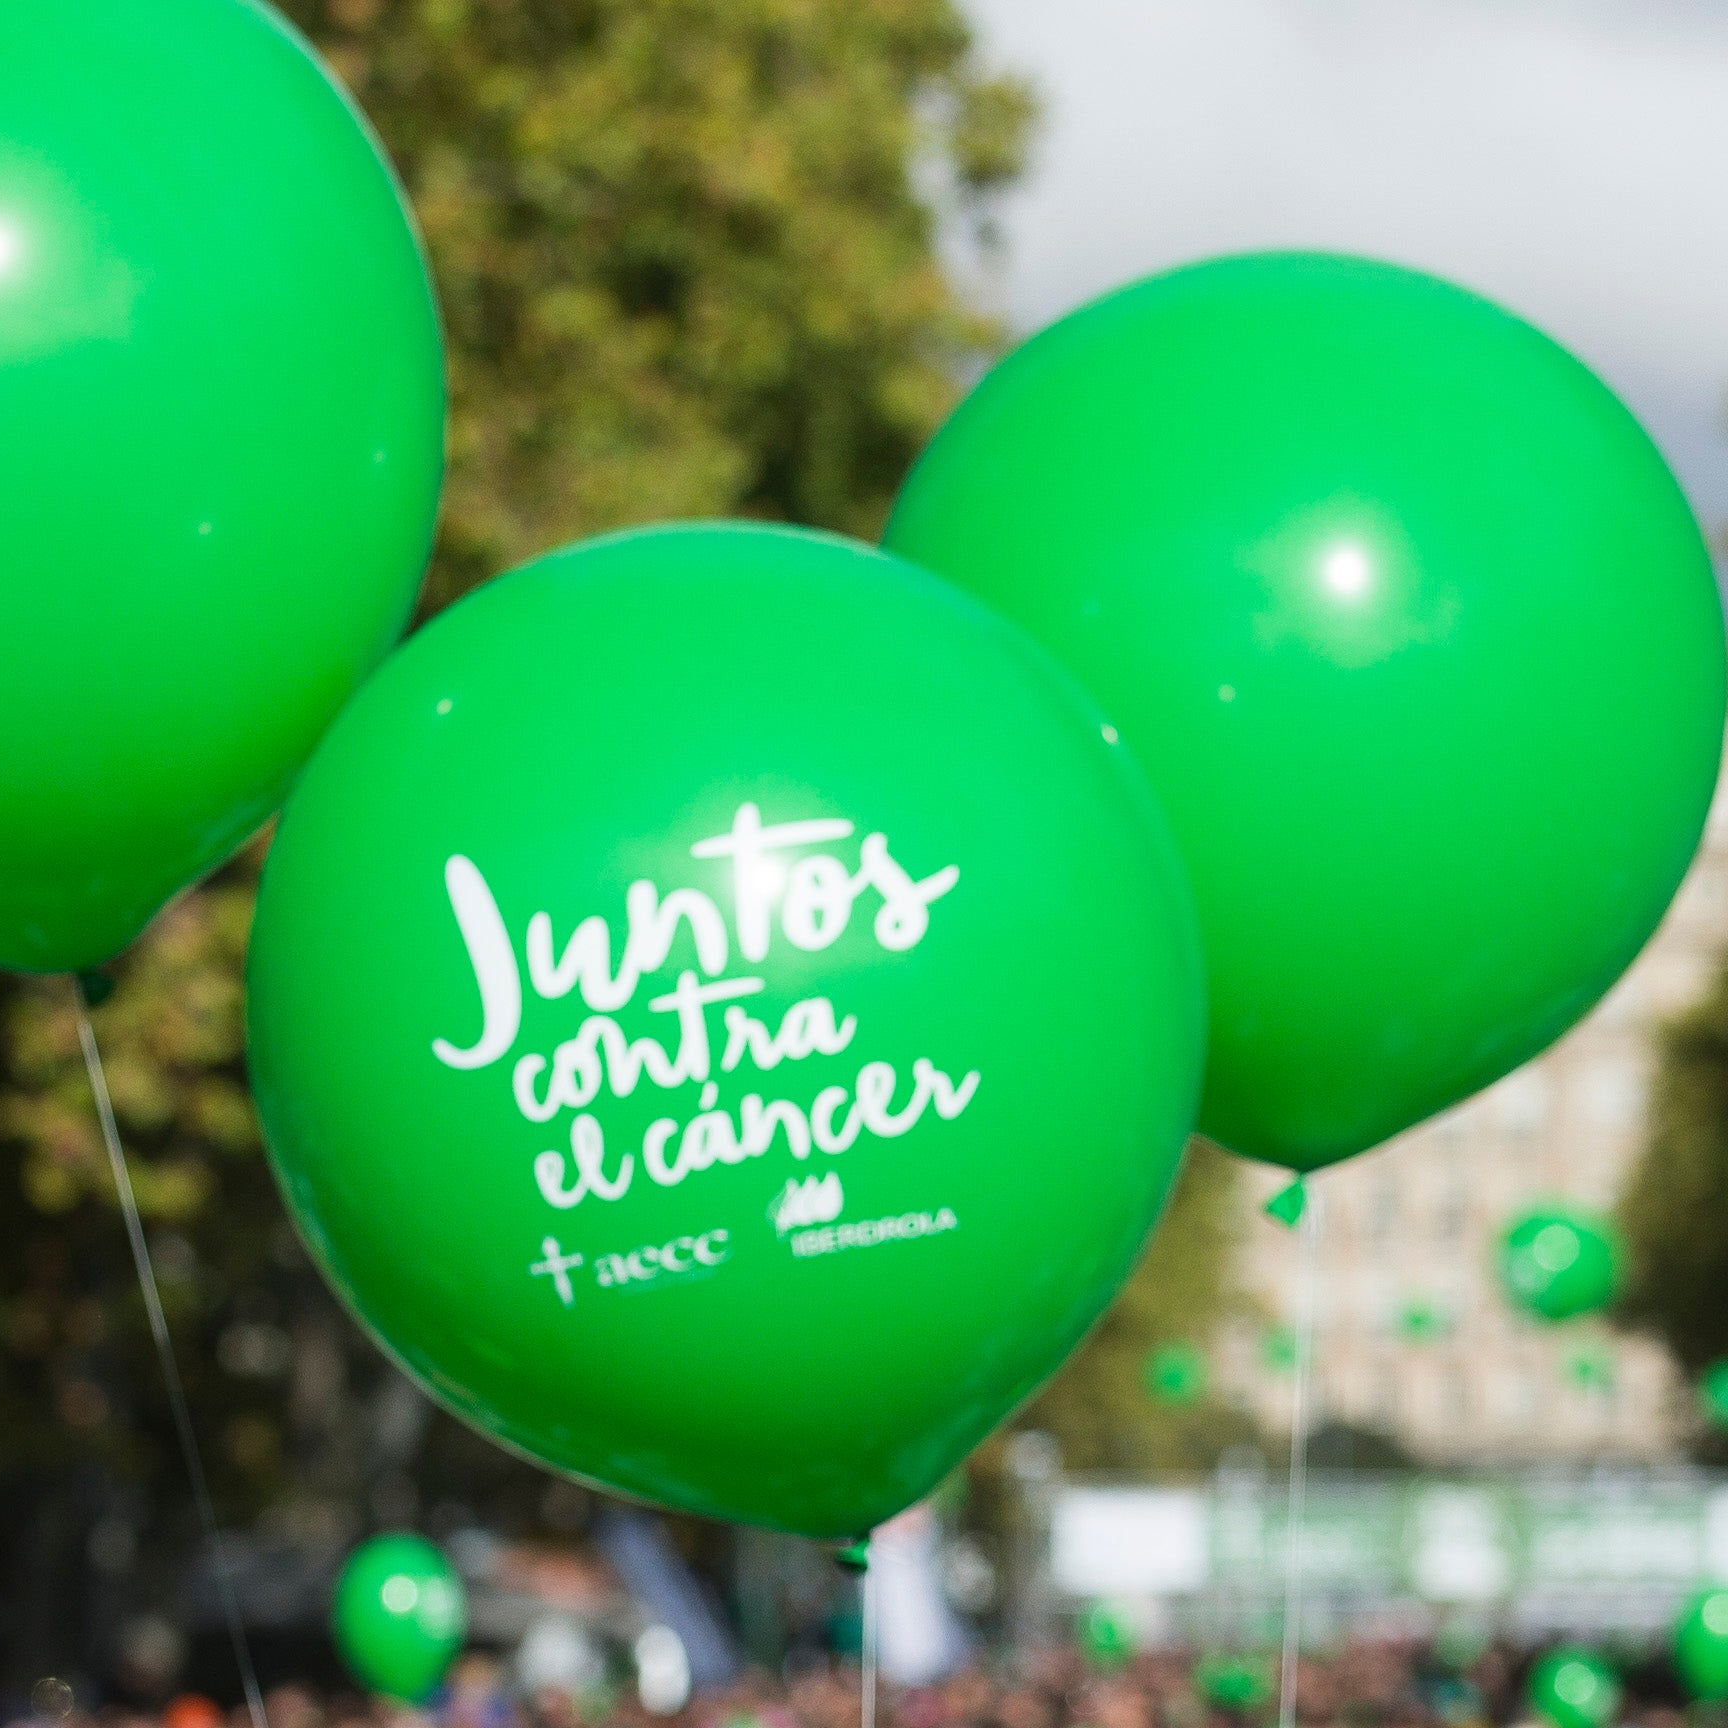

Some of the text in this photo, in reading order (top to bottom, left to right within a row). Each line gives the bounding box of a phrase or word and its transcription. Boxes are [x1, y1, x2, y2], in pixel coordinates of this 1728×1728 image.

[431, 801, 961, 1070] Juntos
[511, 969, 858, 1124] contra
[532, 1057, 981, 1209] el cáncer
[790, 1207, 960, 1257] IBERDROLA
